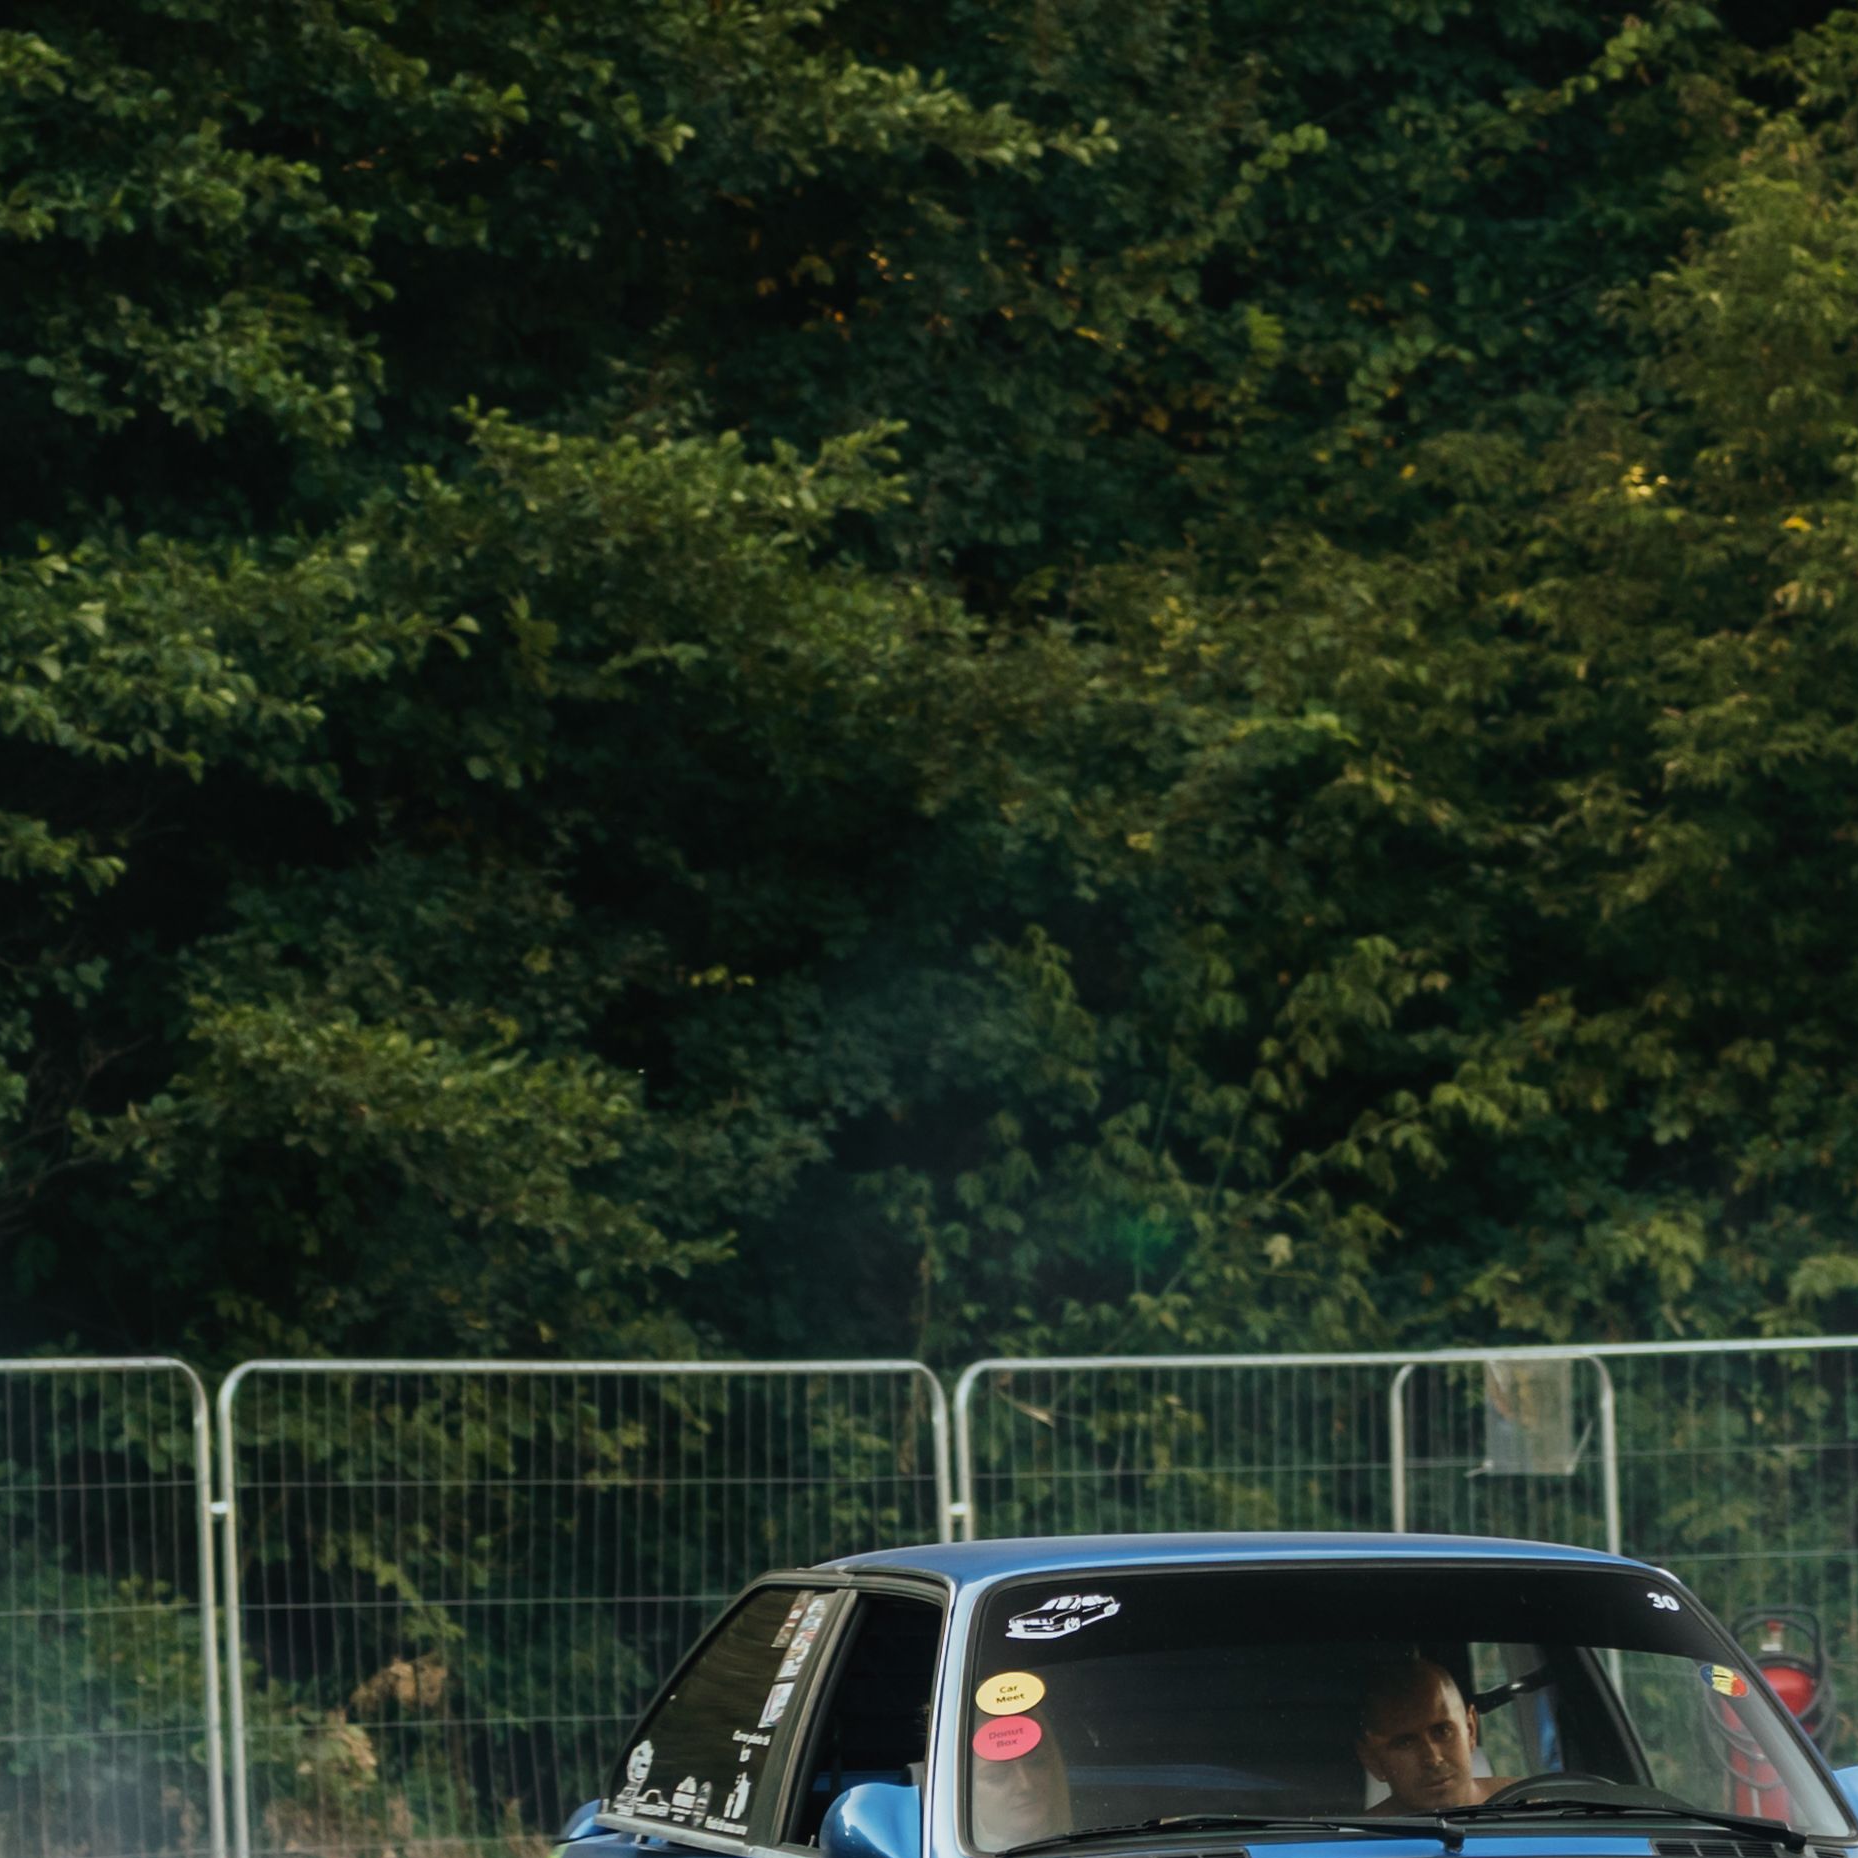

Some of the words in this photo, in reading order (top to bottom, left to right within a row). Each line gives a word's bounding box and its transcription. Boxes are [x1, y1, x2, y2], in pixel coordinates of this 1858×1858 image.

[1647, 1592, 1680, 1612] 30
[999, 1685, 1018, 1693] Car
[996, 1693, 1025, 1703] Meet
[989, 1727, 1024, 1740] Donut
[996, 1738, 1018, 1748] Box
